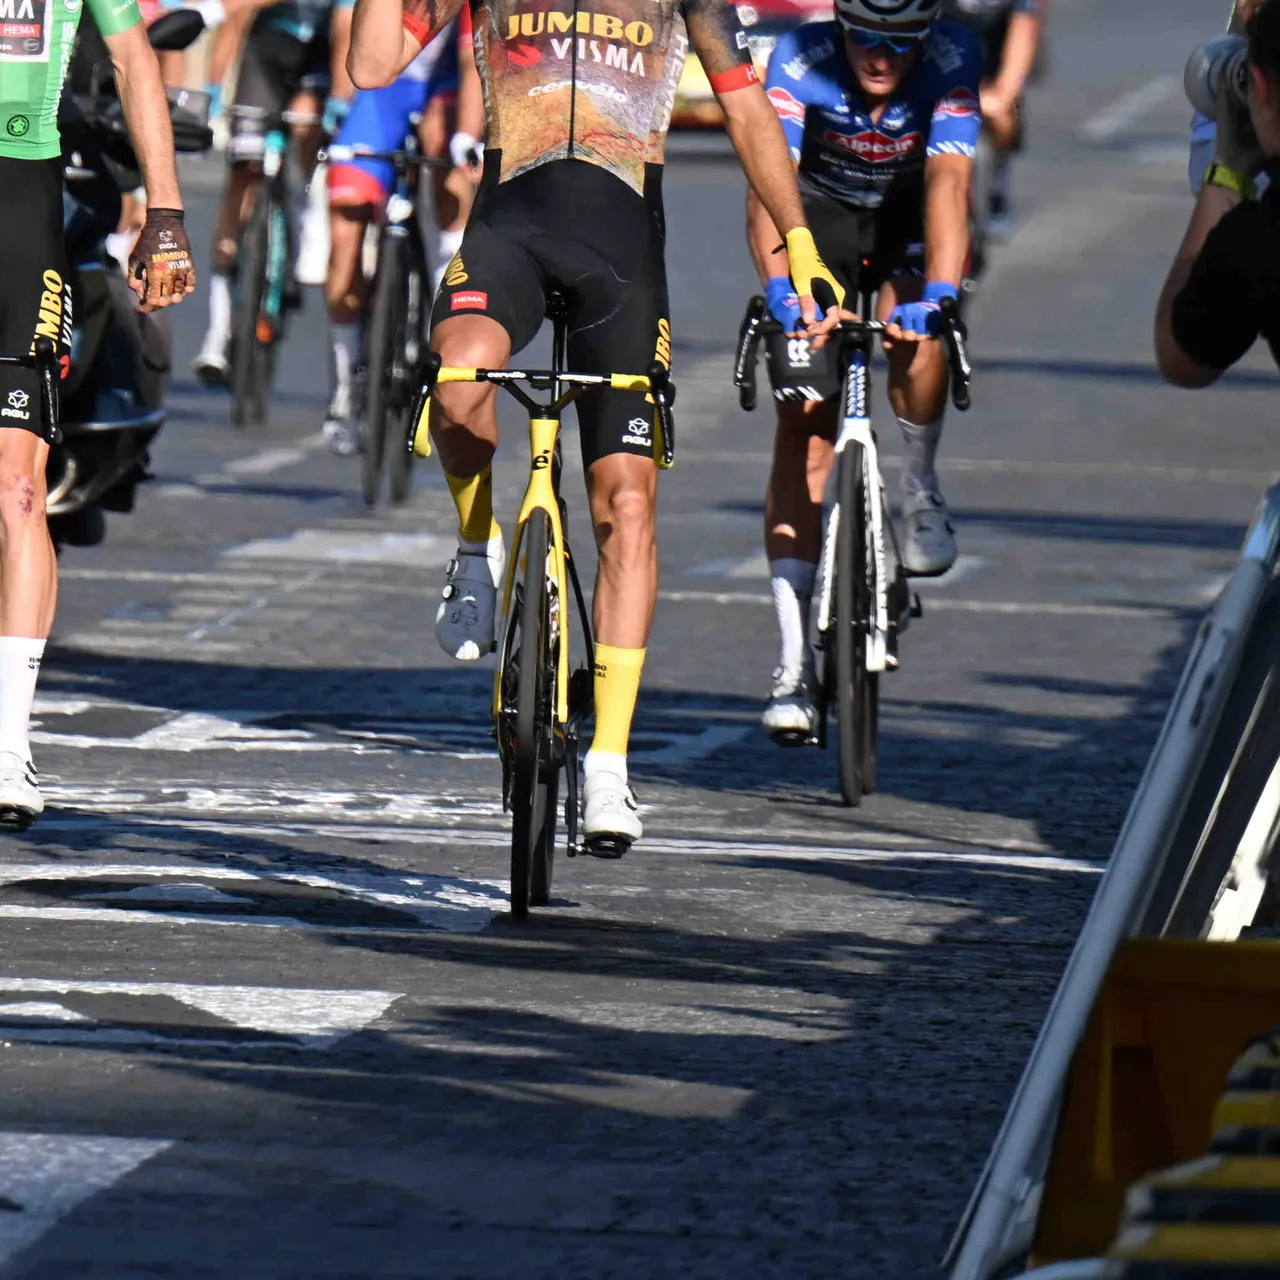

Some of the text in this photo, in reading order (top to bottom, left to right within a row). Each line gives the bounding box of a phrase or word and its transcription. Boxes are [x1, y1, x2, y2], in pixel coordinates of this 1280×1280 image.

[3, 24, 36, 35] HEMA
[505, 11, 653, 46] JUMBO
[550, 37, 645, 77] VISMA
[151, 250, 188, 263] JUMBO
[453, 294, 483, 305] HEMA
[1, 407, 30, 420] AGU
[622, 435, 652, 448] AGU
